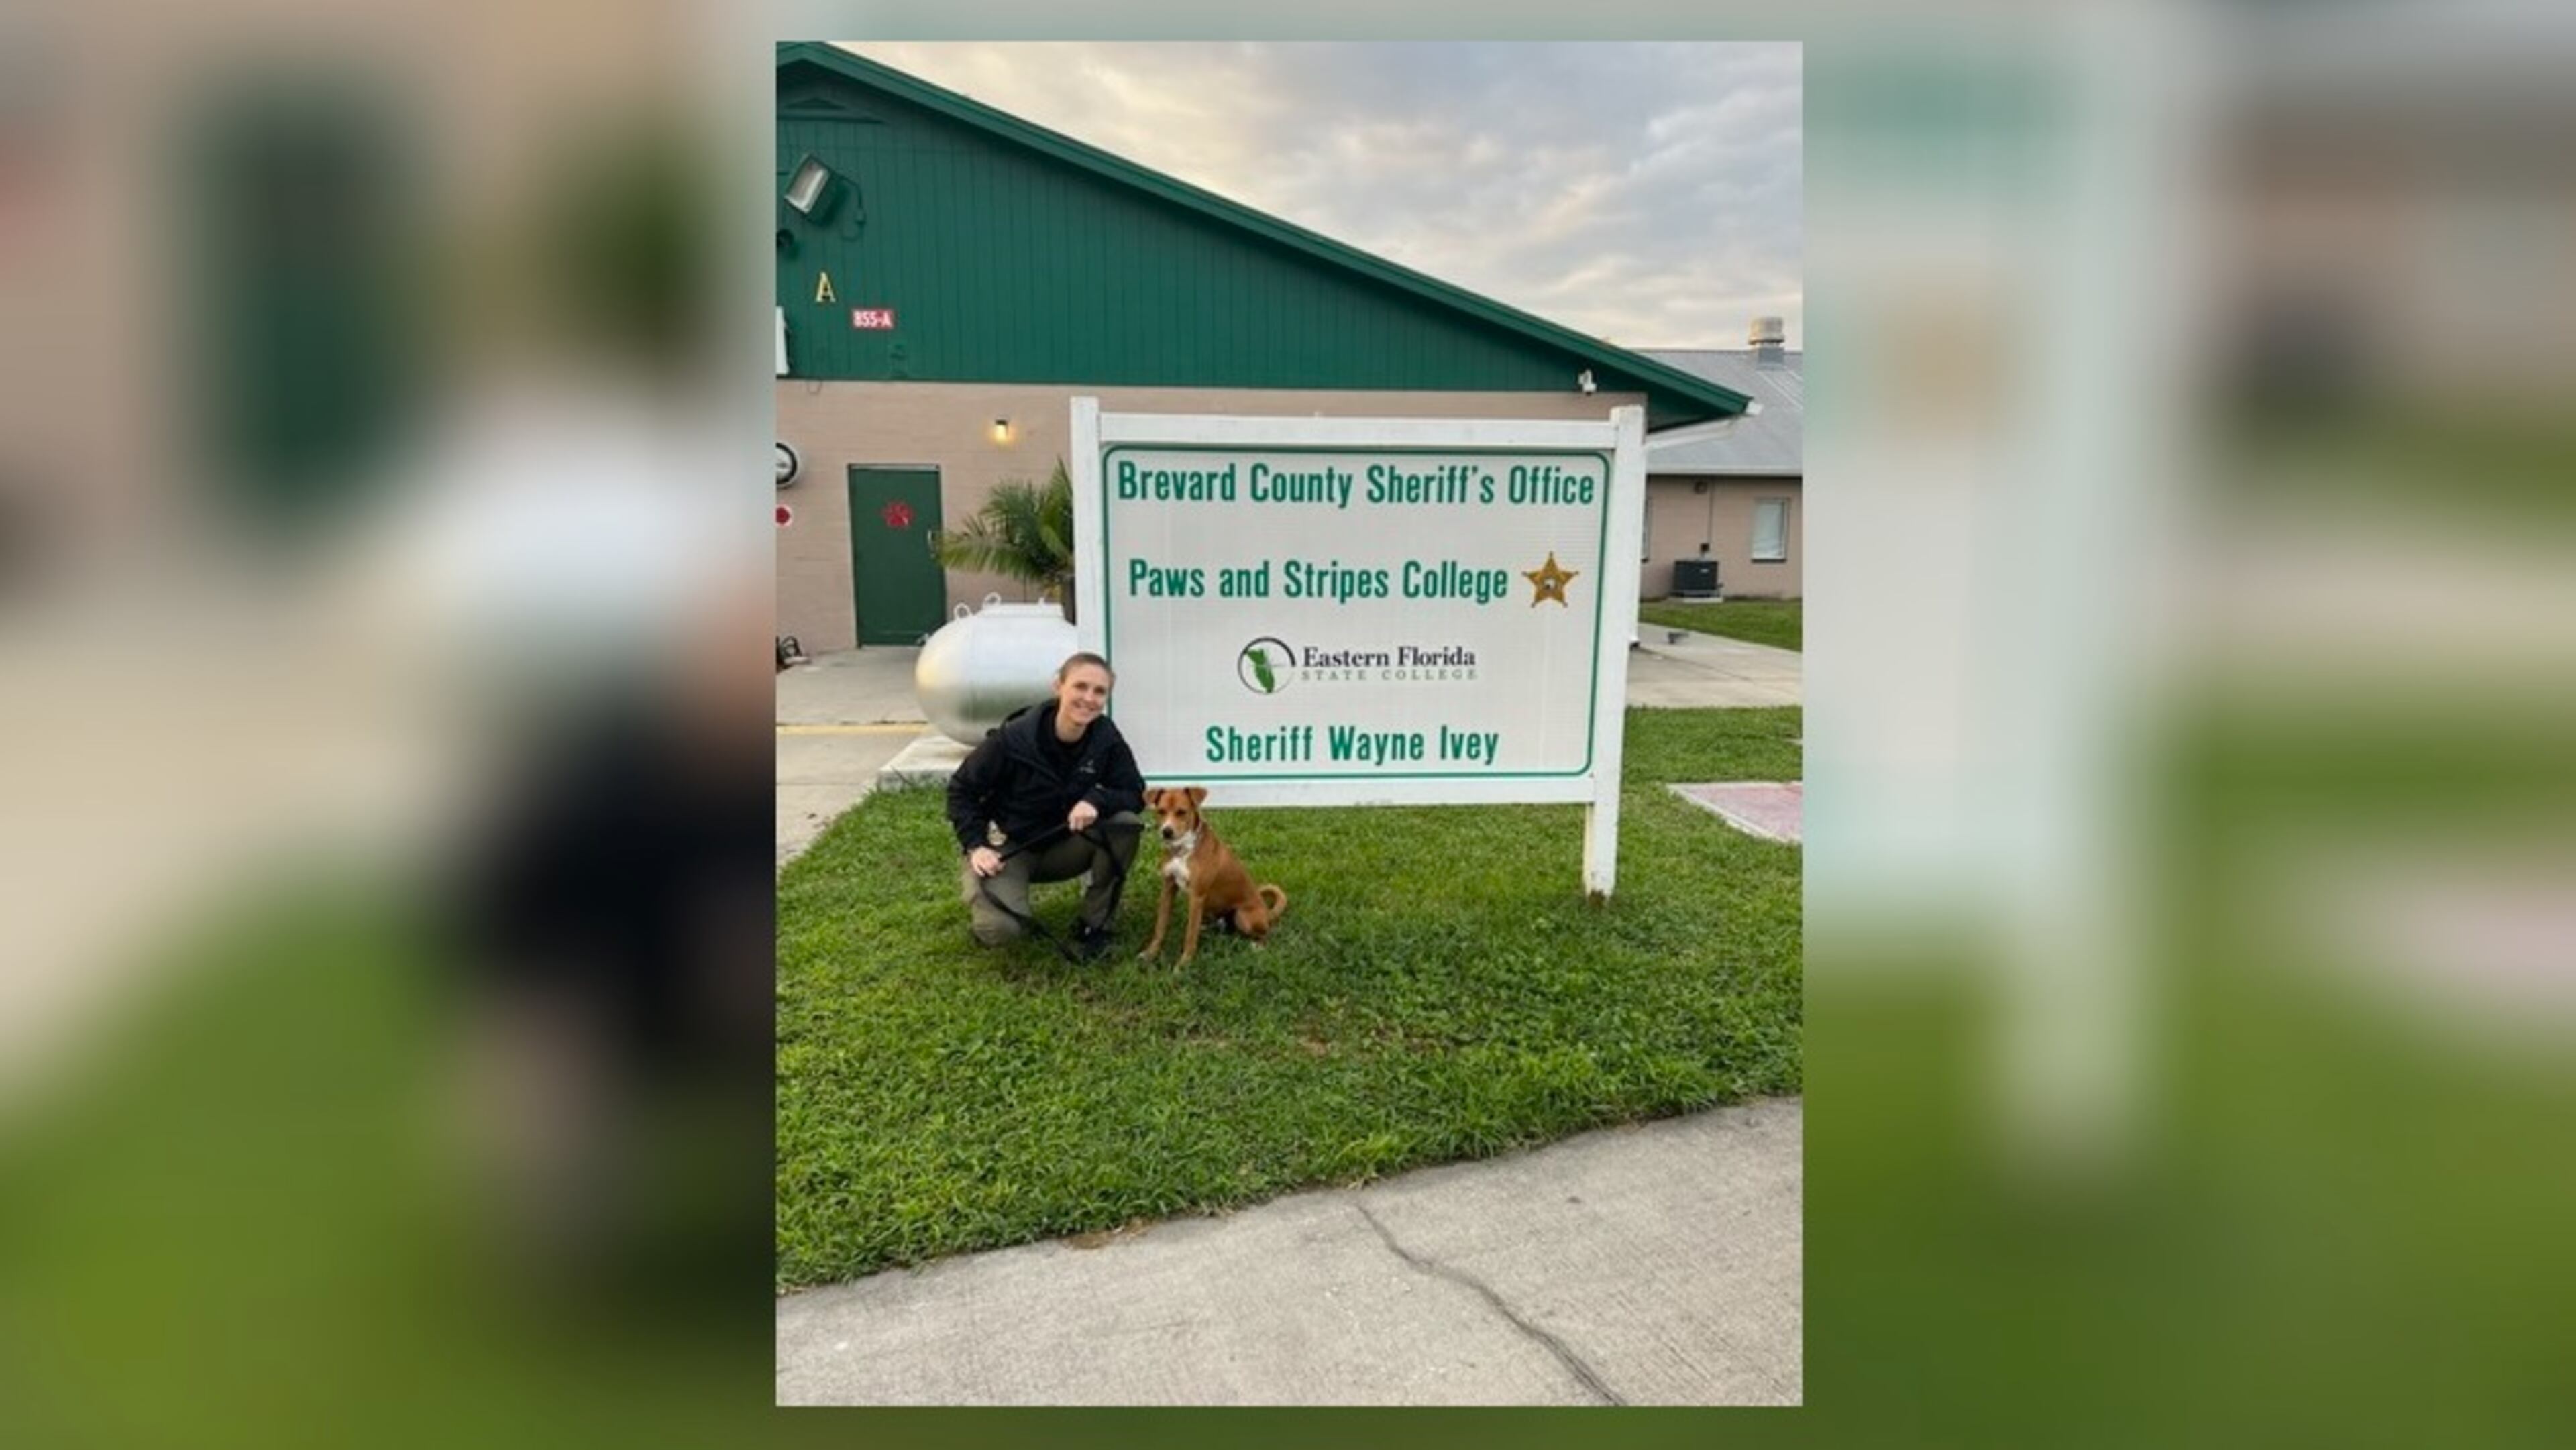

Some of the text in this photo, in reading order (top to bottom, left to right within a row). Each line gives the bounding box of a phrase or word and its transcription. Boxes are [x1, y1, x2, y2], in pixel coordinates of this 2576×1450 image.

[816, 272, 836, 302] A
[1118, 460, 1595, 509] Brevard County Sheriff's Office
[1129, 559, 1509, 605] Paws and Stripes College
[1303, 645, 1477, 668] Eastern Florida
[1301, 669, 1477, 681] STATE COLLEGE
[1205, 725, 1499, 766] Sheriff Wayne Ivey
